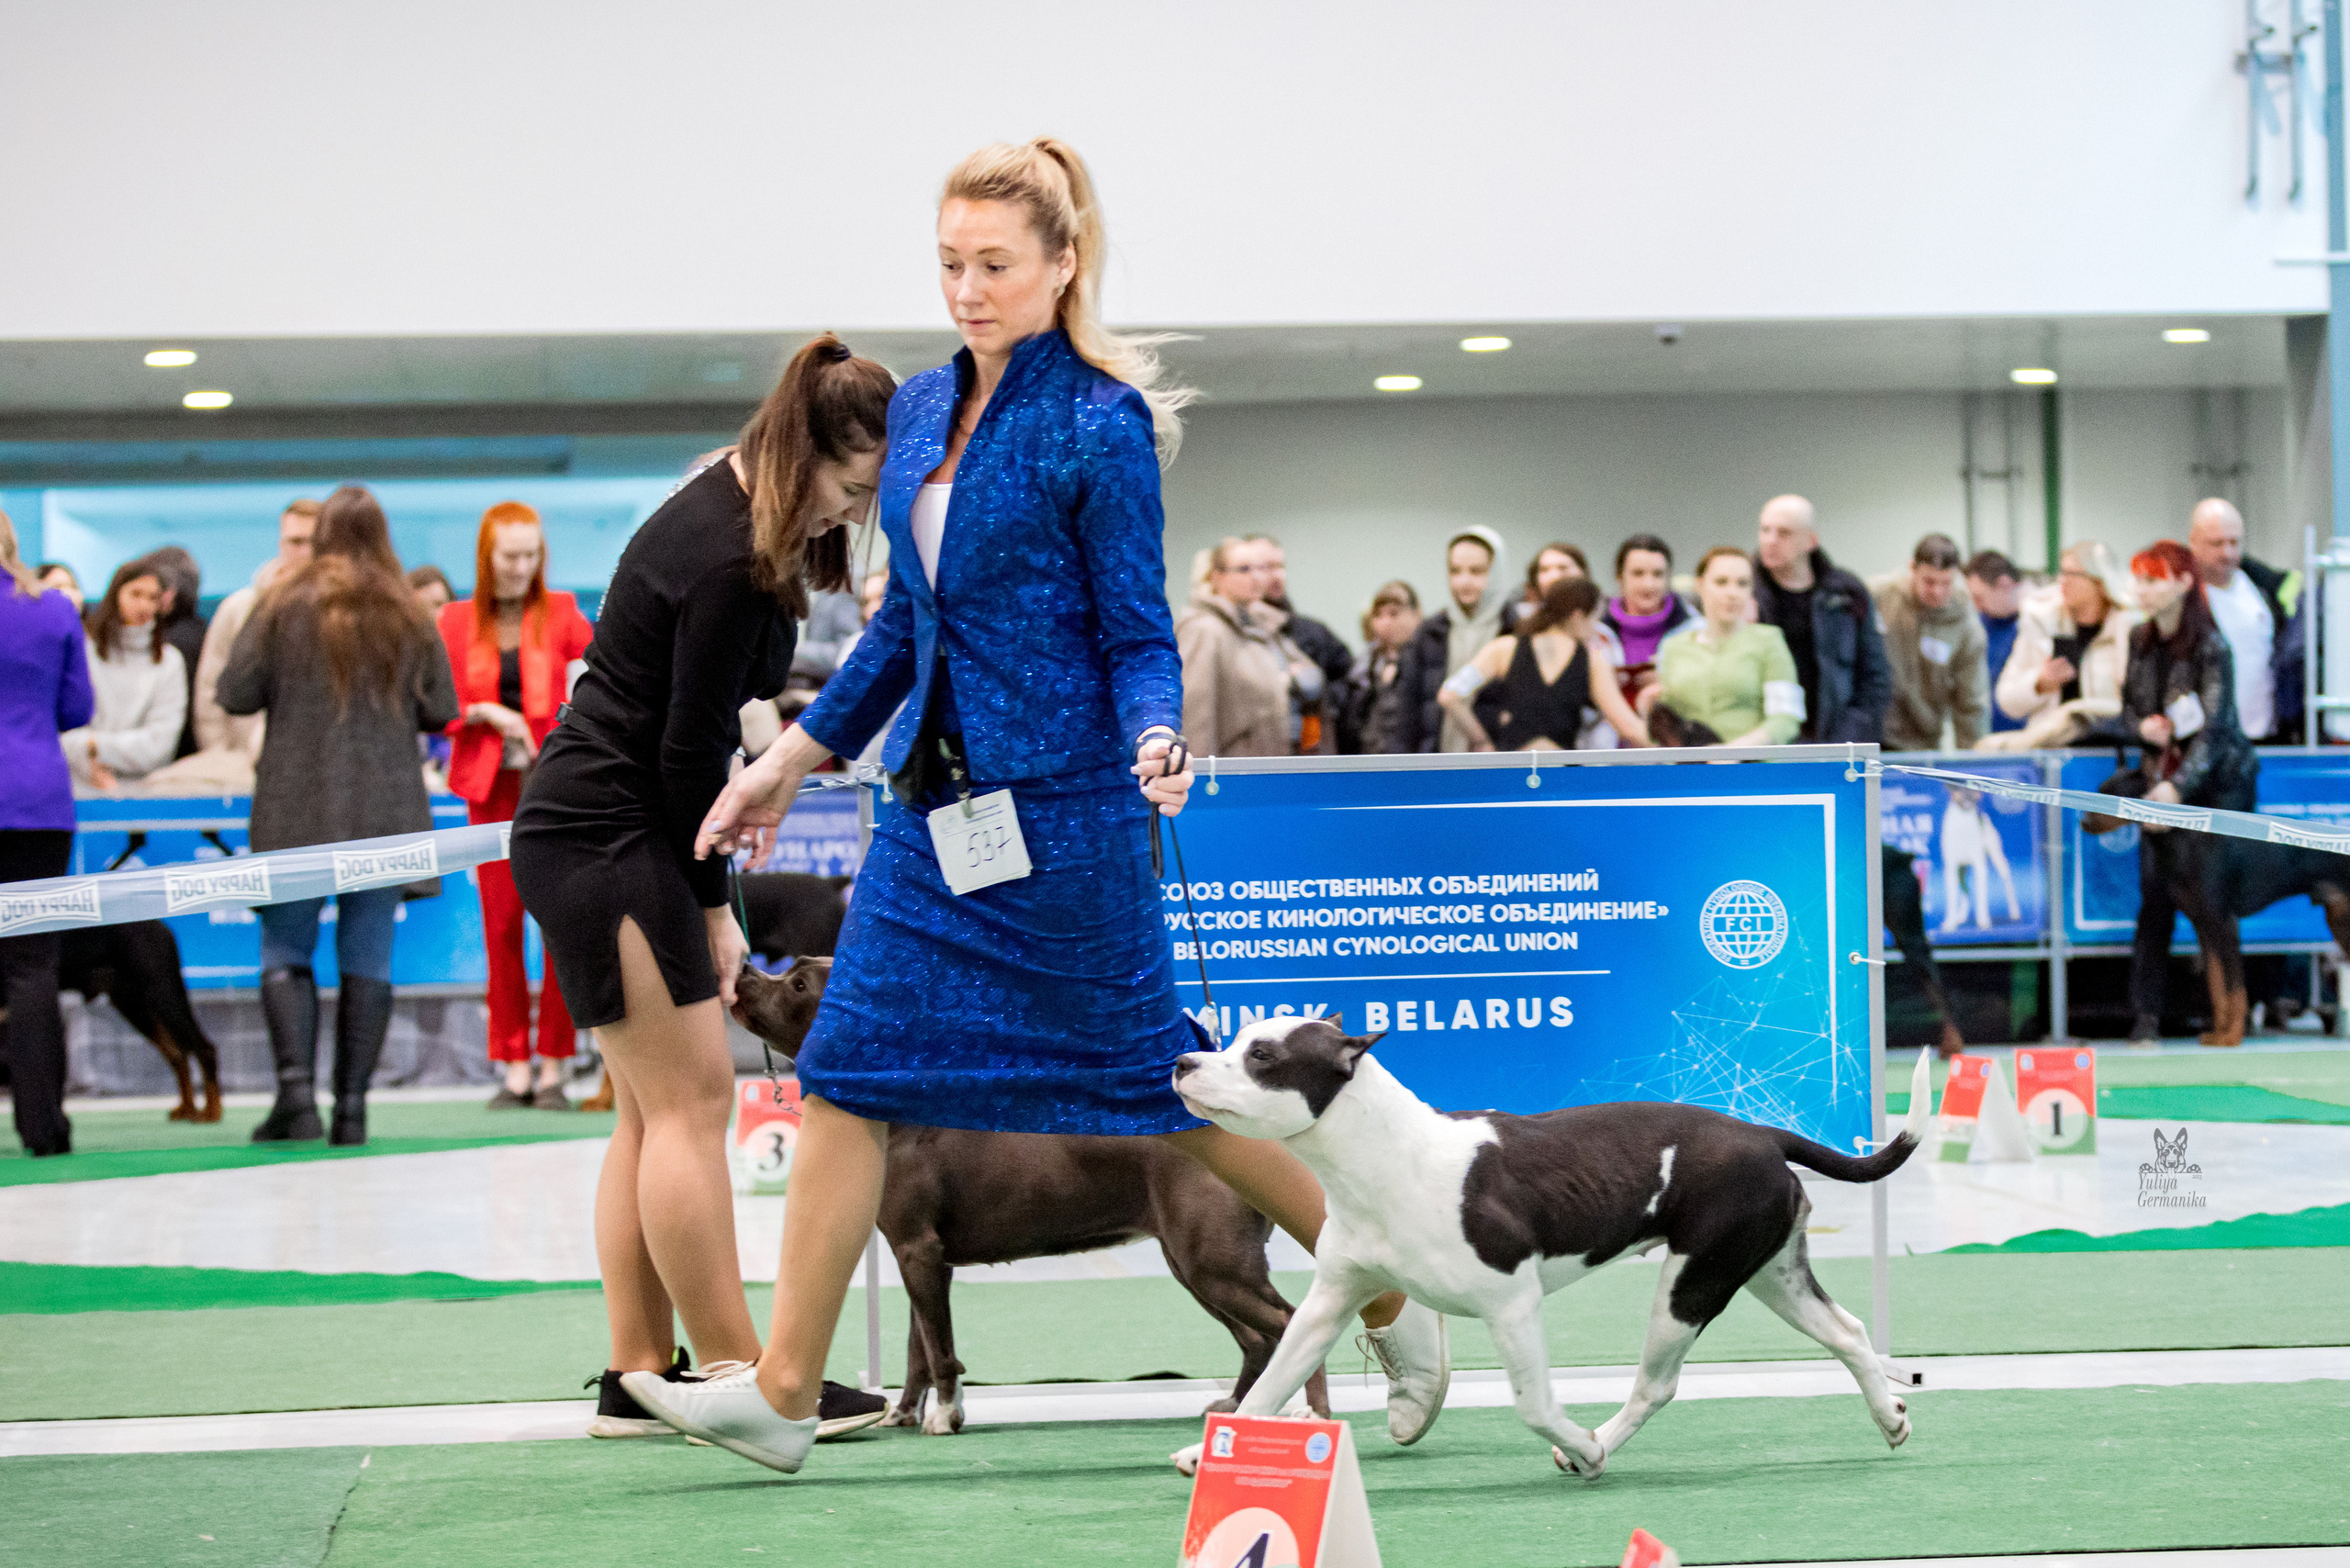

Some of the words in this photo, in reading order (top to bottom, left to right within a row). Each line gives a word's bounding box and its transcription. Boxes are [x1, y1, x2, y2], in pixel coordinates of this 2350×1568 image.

[968, 826, 1013, 868] 537
[1229, 877, 1424, 902] ОБЩЕСТВЕННЫХ
[1427, 868, 1599, 897] ОБЪЕДИНЕНИЙ
[1267, 904, 1484, 929] КИНОЛОГИЧЕСКОЕ
[1489, 901, 1670, 924] ОБЪЕДИНЕНИЕ»
[1725, 916, 1762, 932] FCI
[1173, 937, 1328, 960] BELORUSSIAN
[1333, 934, 1501, 957] CYNOLOGICAL
[1505, 931, 1579, 952] UNION
[1365, 995, 1574, 1033] BELARUS
[2052, 1101, 2063, 1137] 1
[758, 1131, 785, 1171] 3
